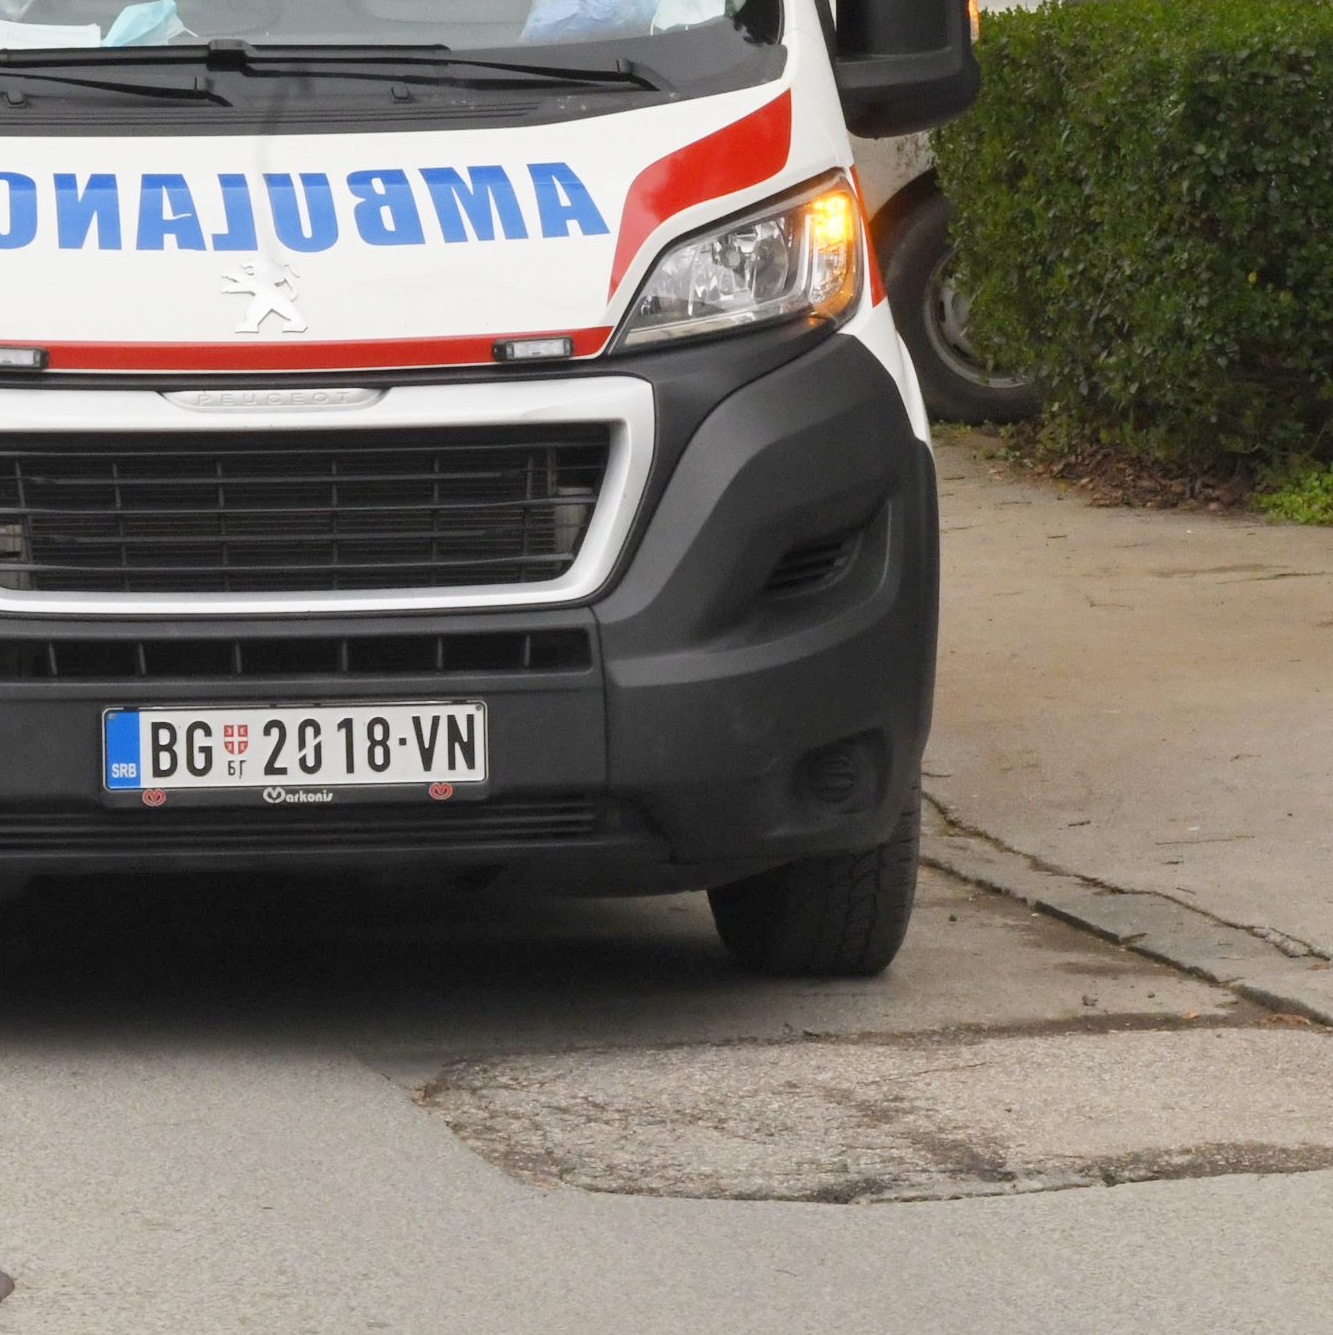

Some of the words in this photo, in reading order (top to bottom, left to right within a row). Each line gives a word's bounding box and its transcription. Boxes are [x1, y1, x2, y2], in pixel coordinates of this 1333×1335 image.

[197, 391, 350, 406] PEUGEOT
[151, 720, 213, 778] BG
[111, 763, 137, 779] SRB
